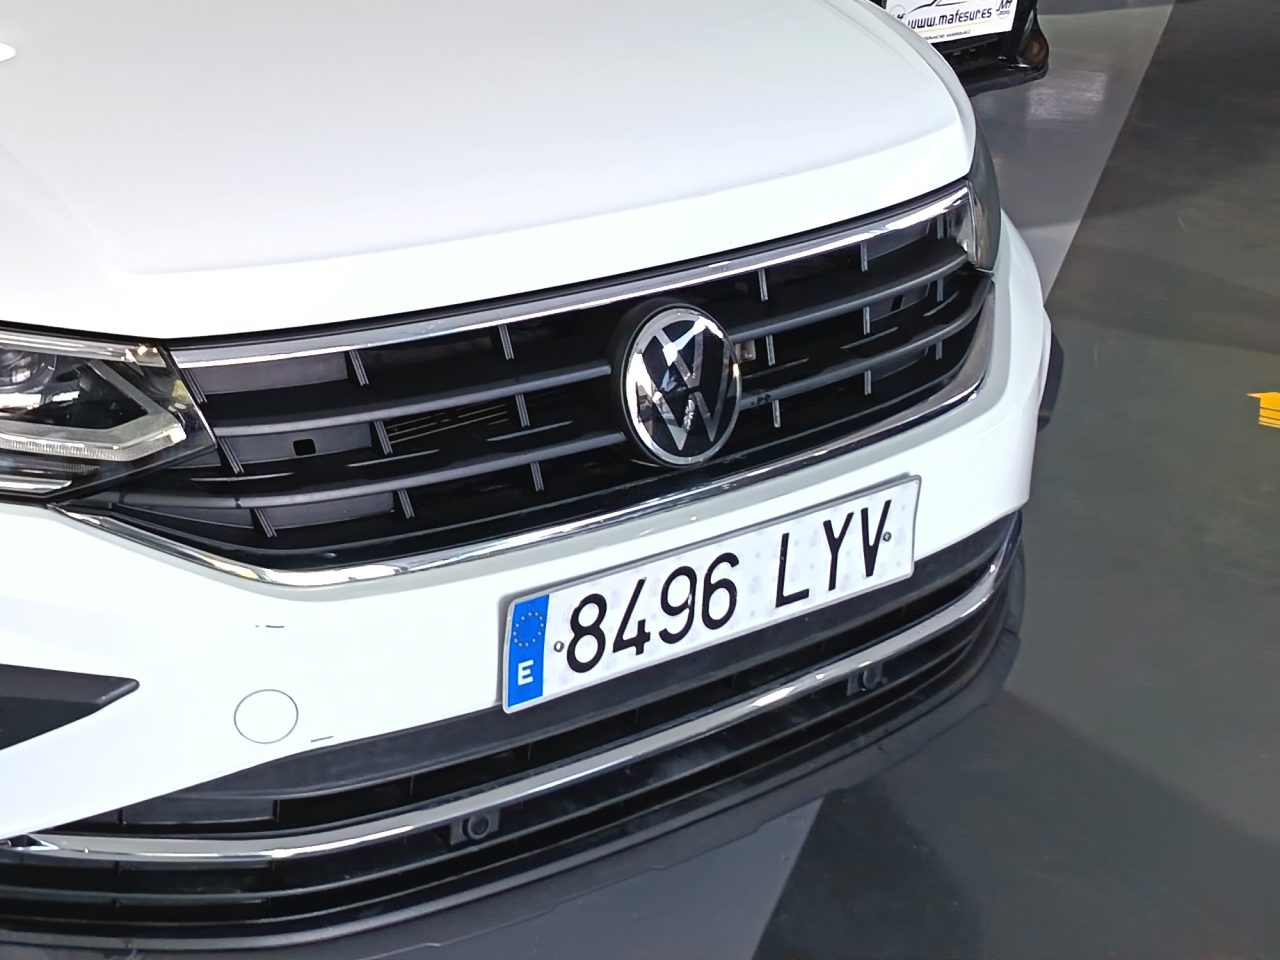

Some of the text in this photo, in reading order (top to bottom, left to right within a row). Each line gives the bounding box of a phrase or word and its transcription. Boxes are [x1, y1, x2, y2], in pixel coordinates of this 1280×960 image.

[567, 499, 892, 673] 8496 LYV
[517, 659, 534, 686] E
